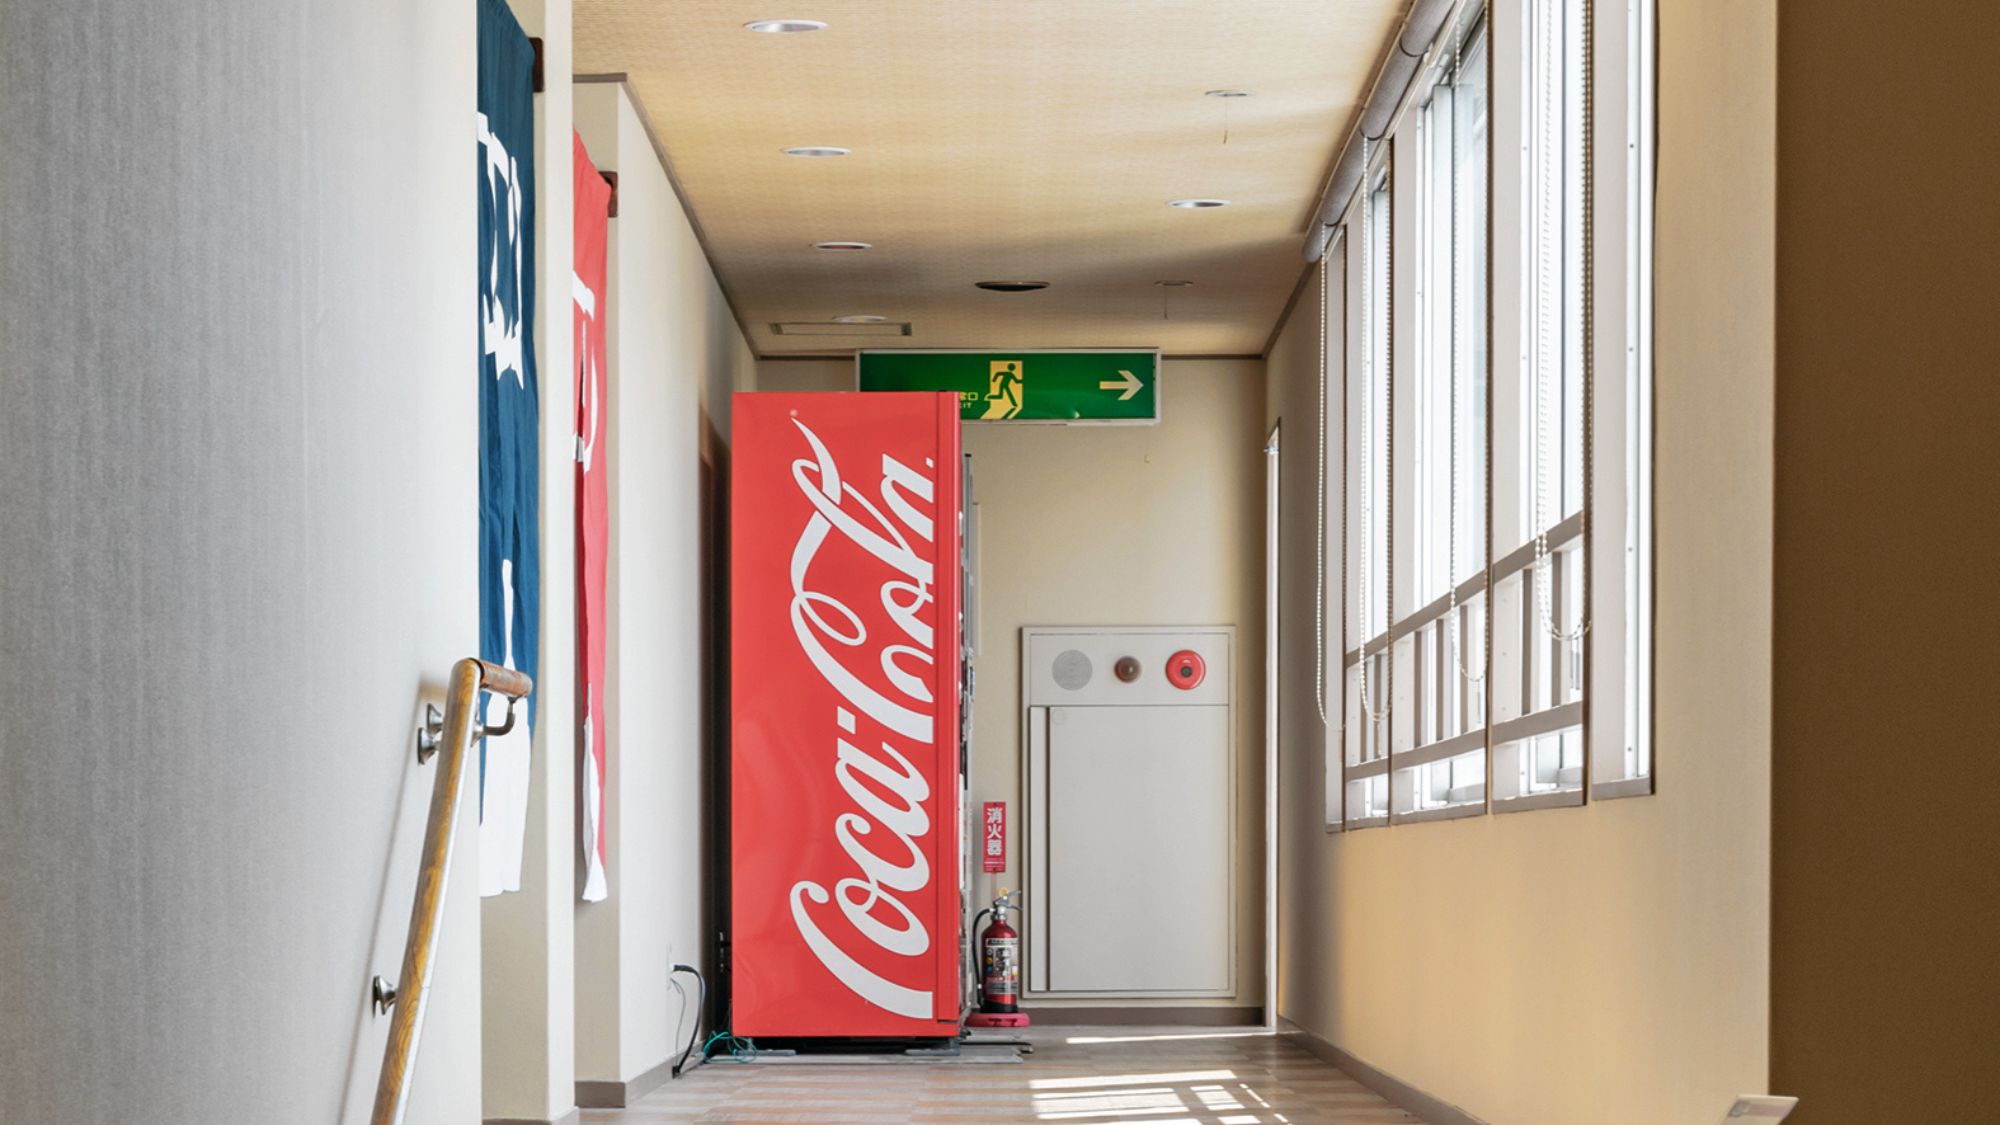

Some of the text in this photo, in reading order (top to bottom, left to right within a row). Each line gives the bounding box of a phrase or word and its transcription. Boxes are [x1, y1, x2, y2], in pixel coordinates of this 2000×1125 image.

[791, 418, 934, 1018] Coca-Cola
[987, 807, 1003, 856] 消火器
